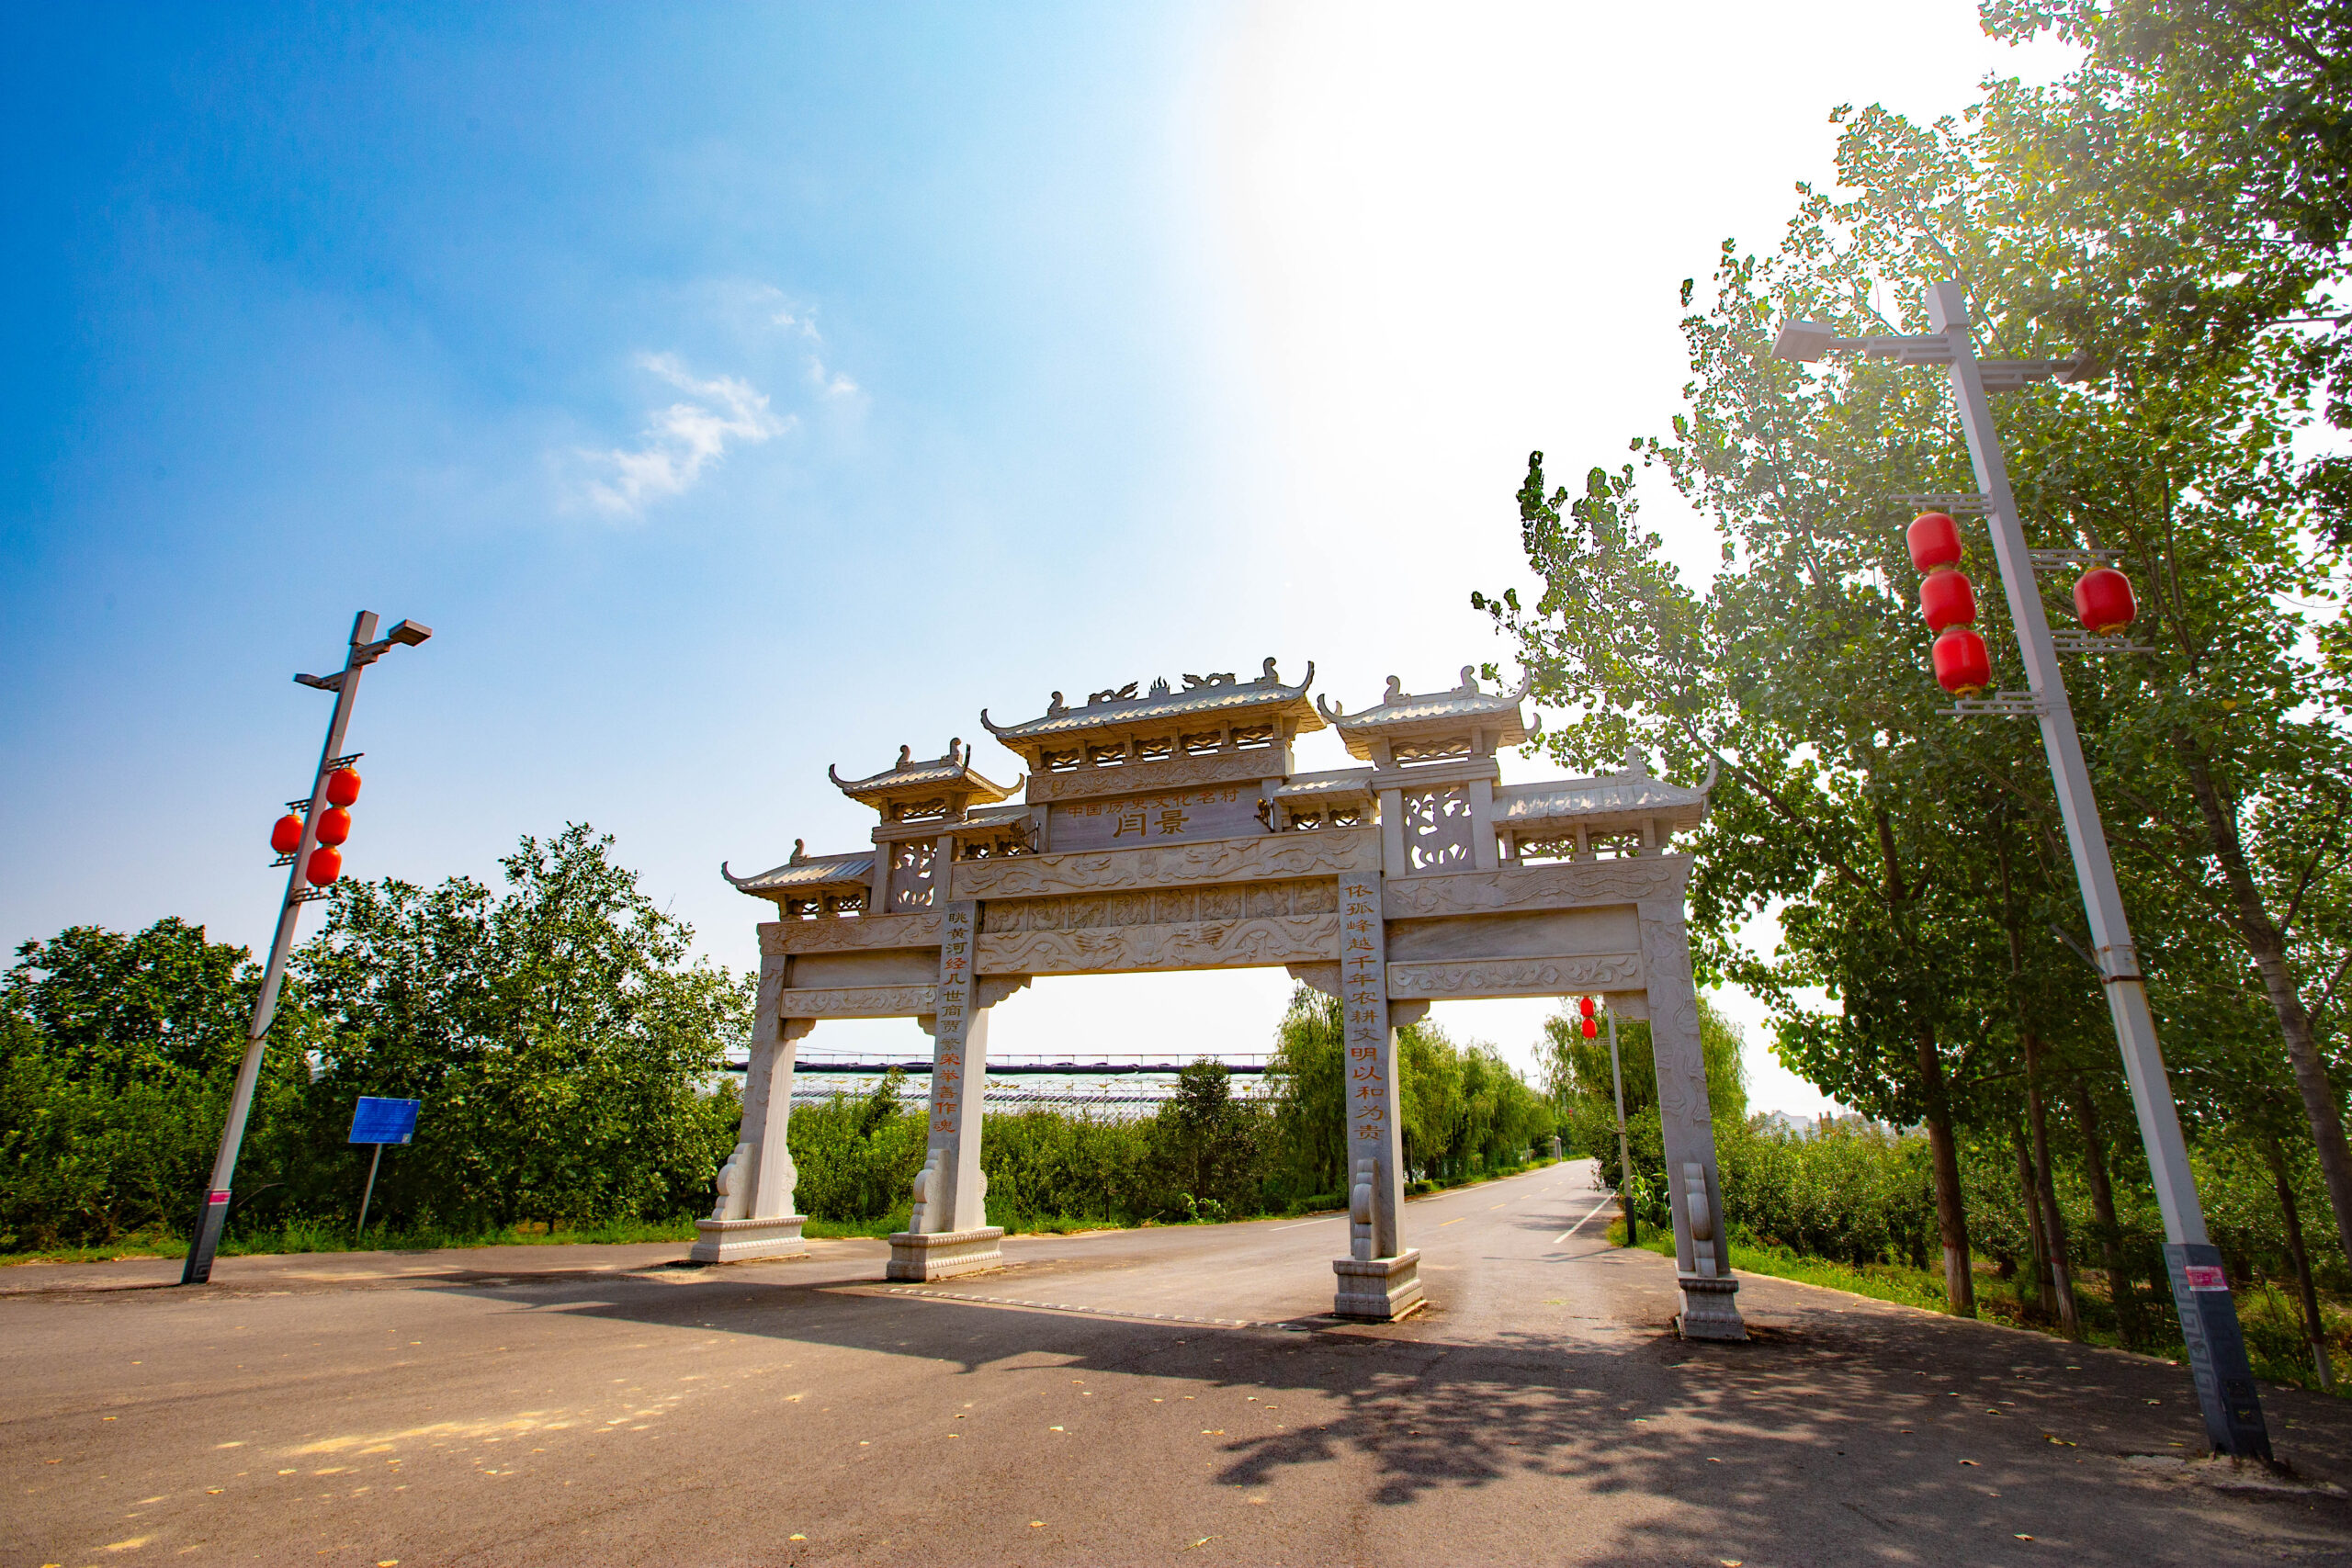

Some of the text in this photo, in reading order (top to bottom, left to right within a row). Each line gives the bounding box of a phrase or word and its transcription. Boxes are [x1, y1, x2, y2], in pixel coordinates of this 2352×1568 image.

[1068, 789, 1239, 818] 中国历史文化名村
[1113, 809, 1191, 838] 闫景
[933, 912, 969, 1134] 眺黄河经几世商贾繁荣举善作魂
[1345, 884, 1385, 1141] 依孤峰越千年农耕文明以和为贵
